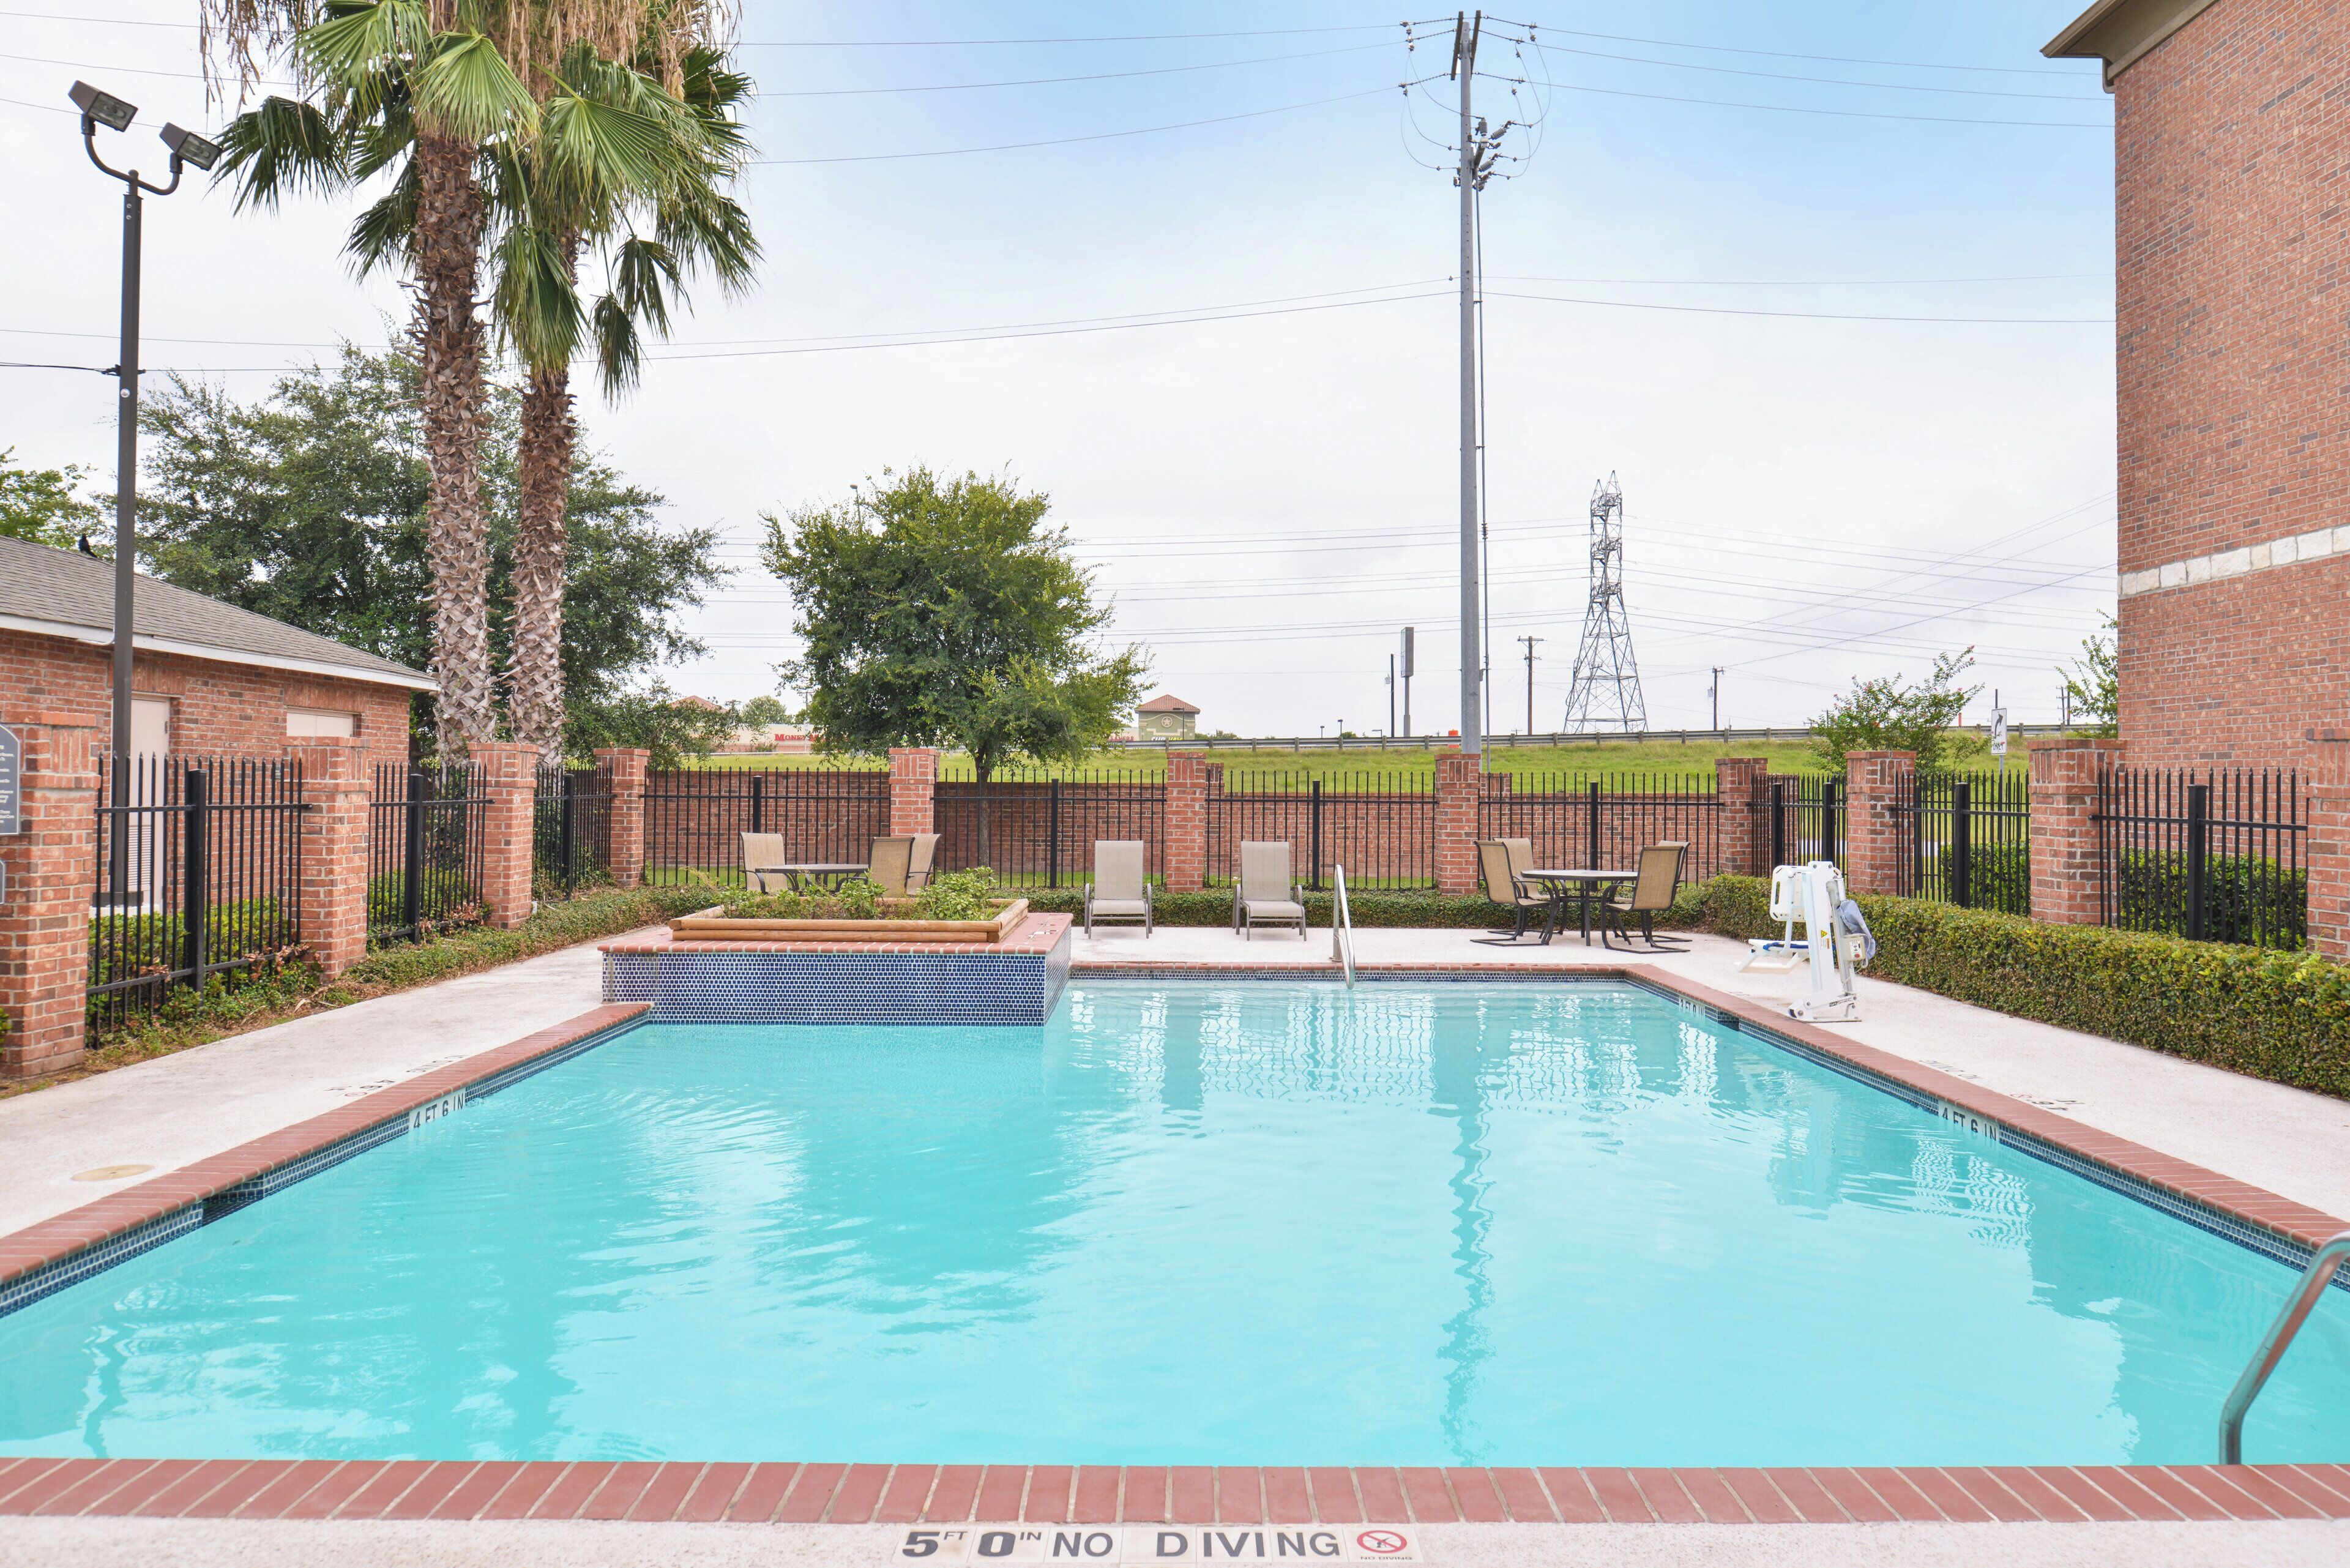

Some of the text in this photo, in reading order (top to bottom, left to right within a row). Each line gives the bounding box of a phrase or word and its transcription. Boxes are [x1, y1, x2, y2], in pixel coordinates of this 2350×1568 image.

[413, 1093, 464, 1129] 4 FT 6 IN
[1942, 1107, 1948, 1120] 4
[1953, 1111, 1966, 1127] FT
[1985, 1123, 1996, 1141] IN
[902, 1531, 1340, 1558] 5 FT 0 IN NO DIVING
